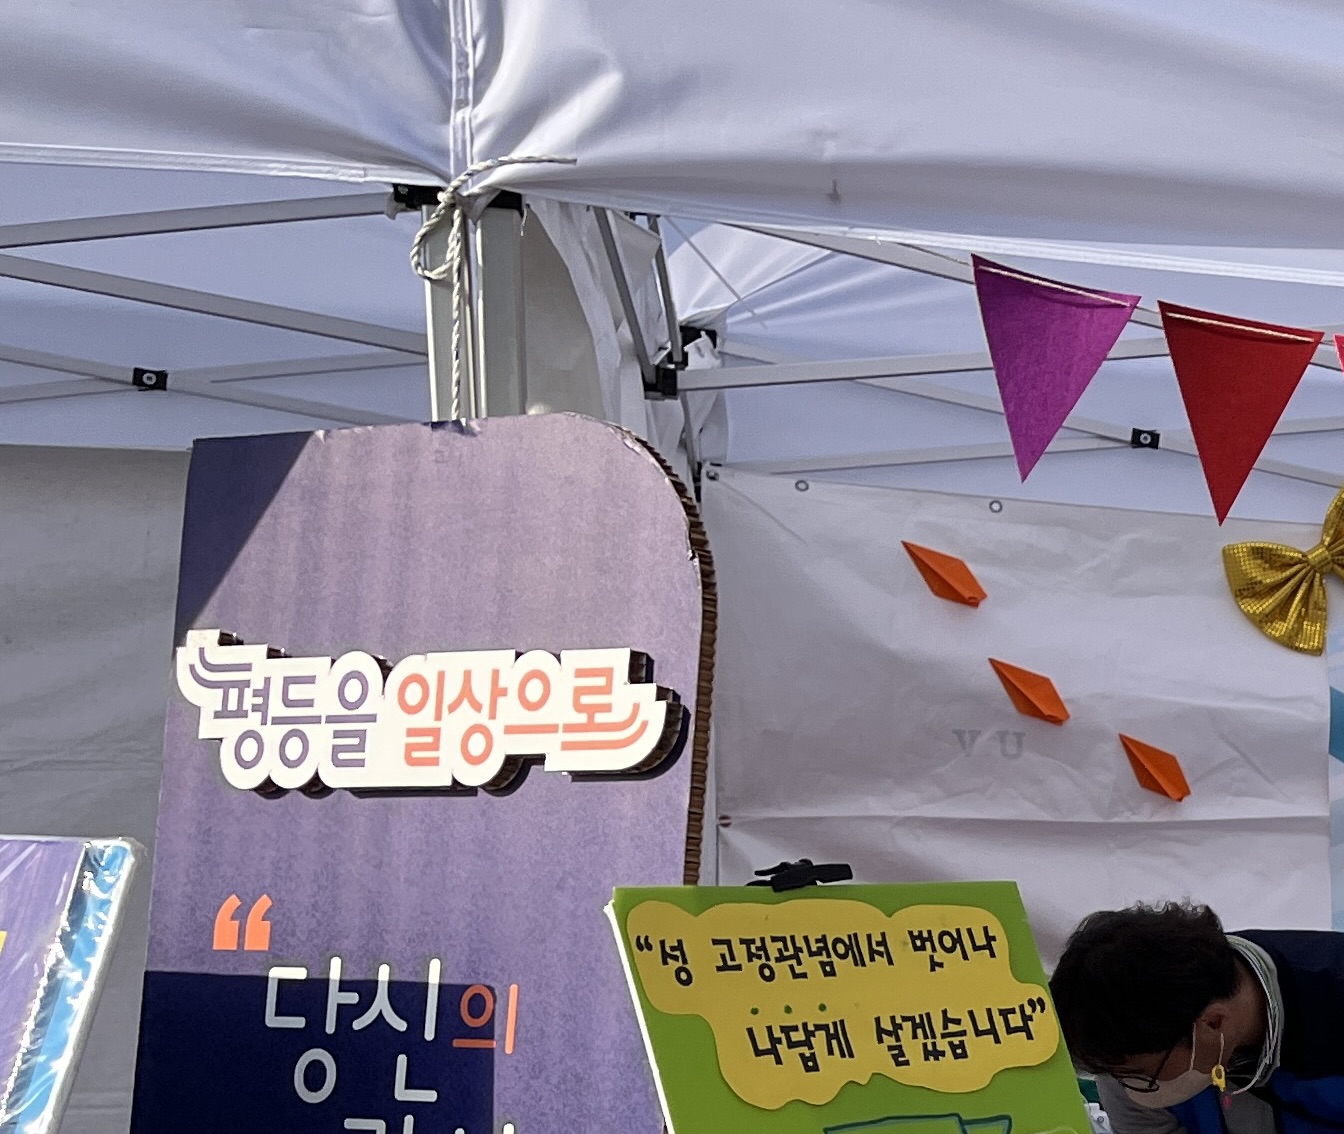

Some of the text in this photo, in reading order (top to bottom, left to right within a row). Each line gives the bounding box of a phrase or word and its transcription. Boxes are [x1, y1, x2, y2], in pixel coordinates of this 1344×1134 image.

[193, 651, 648, 769] 평등을 일상으로
[710, 930, 894, 983] 고정관념에서
[907, 925, 998, 973] 벗어나
[264, 956, 520, 1104] 당신의
[745, 1018, 856, 1073] 나답게
